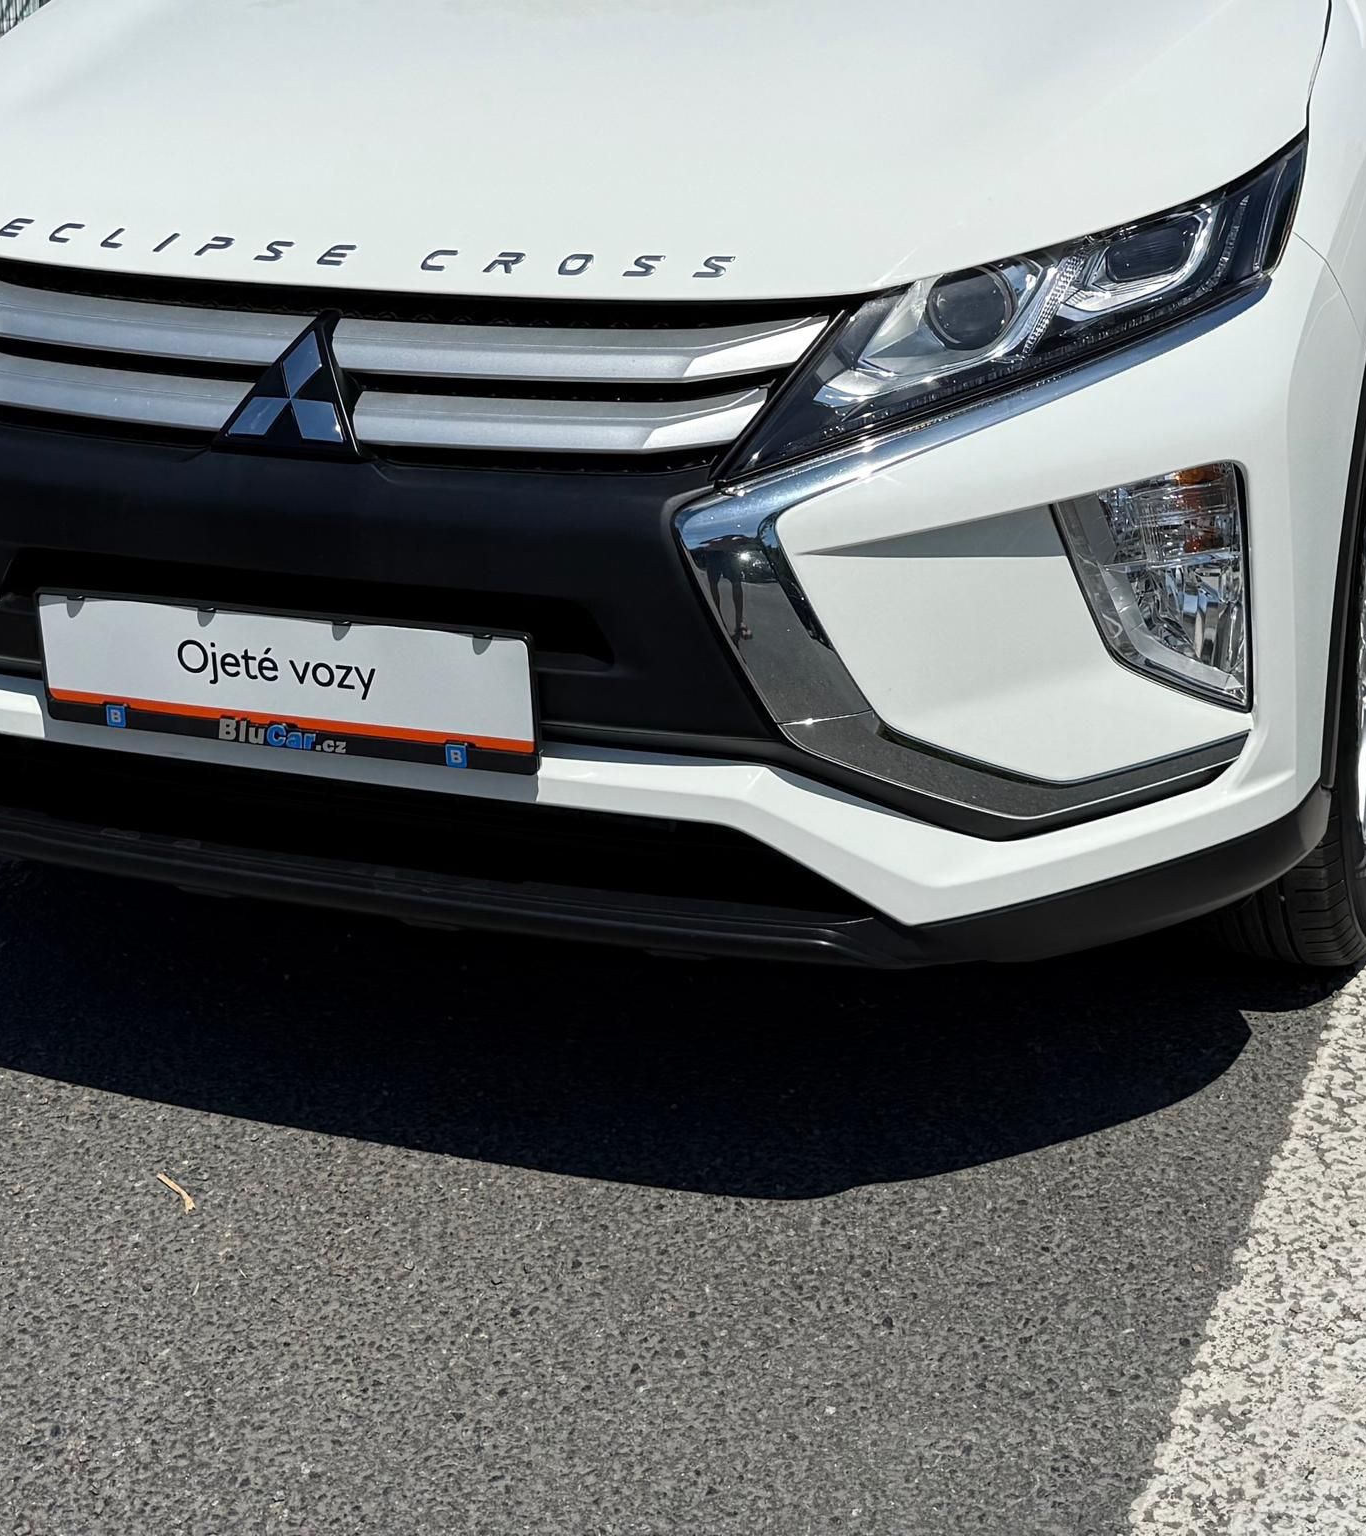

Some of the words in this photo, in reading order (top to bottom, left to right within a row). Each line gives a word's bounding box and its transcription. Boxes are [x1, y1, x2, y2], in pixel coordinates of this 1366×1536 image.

[420, 249, 736, 278] CROSS
[176, 639, 279, 684] Ojeté
[290, 660, 376, 700] vozy
[218, 718, 347, 754] BluCar.cz
